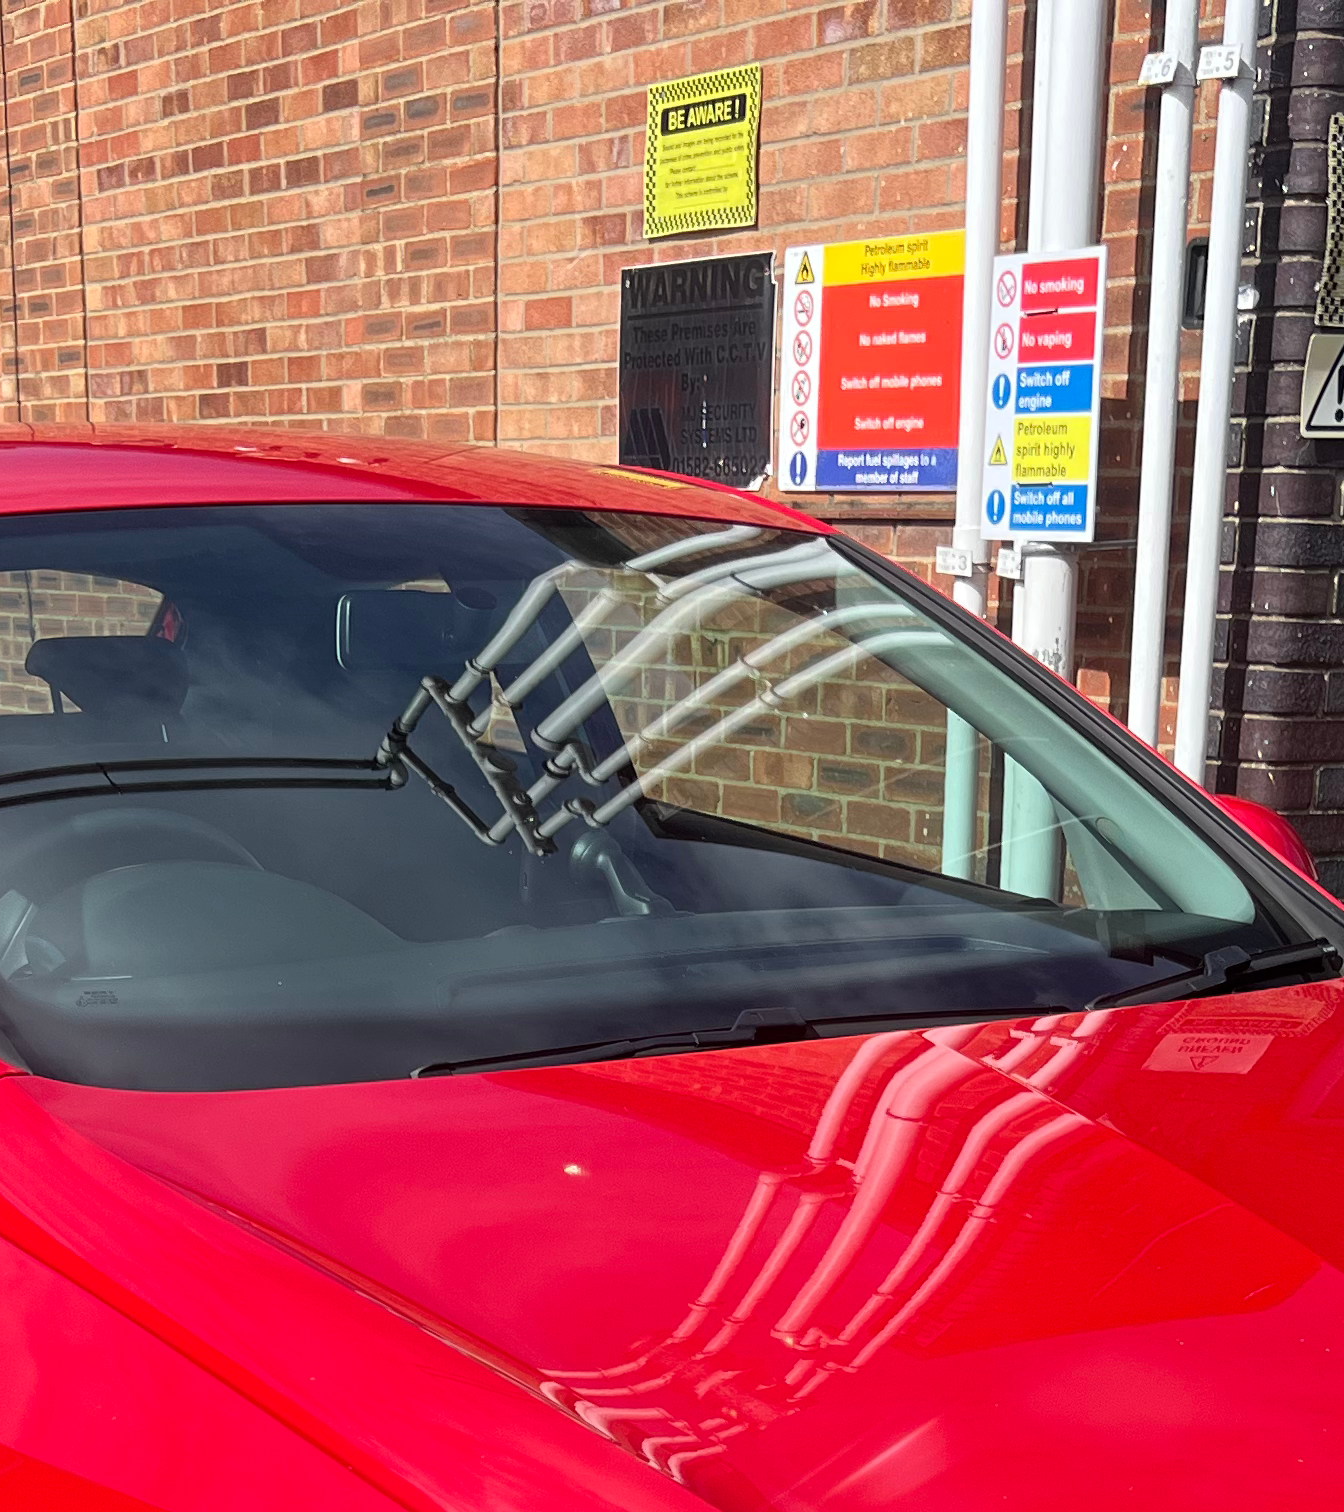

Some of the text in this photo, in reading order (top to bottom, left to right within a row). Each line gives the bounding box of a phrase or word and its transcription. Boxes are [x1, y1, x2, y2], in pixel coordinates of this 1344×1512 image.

[668, 109, 685, 131] BE
[687, 100, 732, 127] AWARE
[864, 240, 929, 257] Petroleum spirit
[861, 258, 931, 277] Highly flammable
[629, 259, 765, 310] WARNING
[1024, 277, 1085, 295] No smoking
[869, 292, 920, 308] No Smoking
[634, 318, 757, 344] These Premises Are
[859, 330, 927, 346] No naked flames
[1021, 331, 1073, 350] No vaping
[624, 349, 681, 369] Protected
[684, 345, 712, 365] With
[681, 373, 700, 395] By:
[841, 374, 942, 390] Switch off mobile phones
[1019, 370, 1071, 388] Switch off
[1018, 393, 1052, 411] engine
[854, 416, 924, 432] Switch off engine
[1017, 421, 1068, 436] Petroleum
[736, 426, 757, 444] LTD
[1016, 442, 1075, 460] spirit highly
[838, 453, 864, 470] Report
[865, 453, 882, 467] fuel
[920, 453, 929, 466] to
[855, 470, 919, 484] member of staff
[1016, 463, 1067, 478] flammable
[1013, 491, 1074, 506] Switch off all
[1012, 511, 1083, 527] mobile phones
[958, 554, 968, 571] 3
